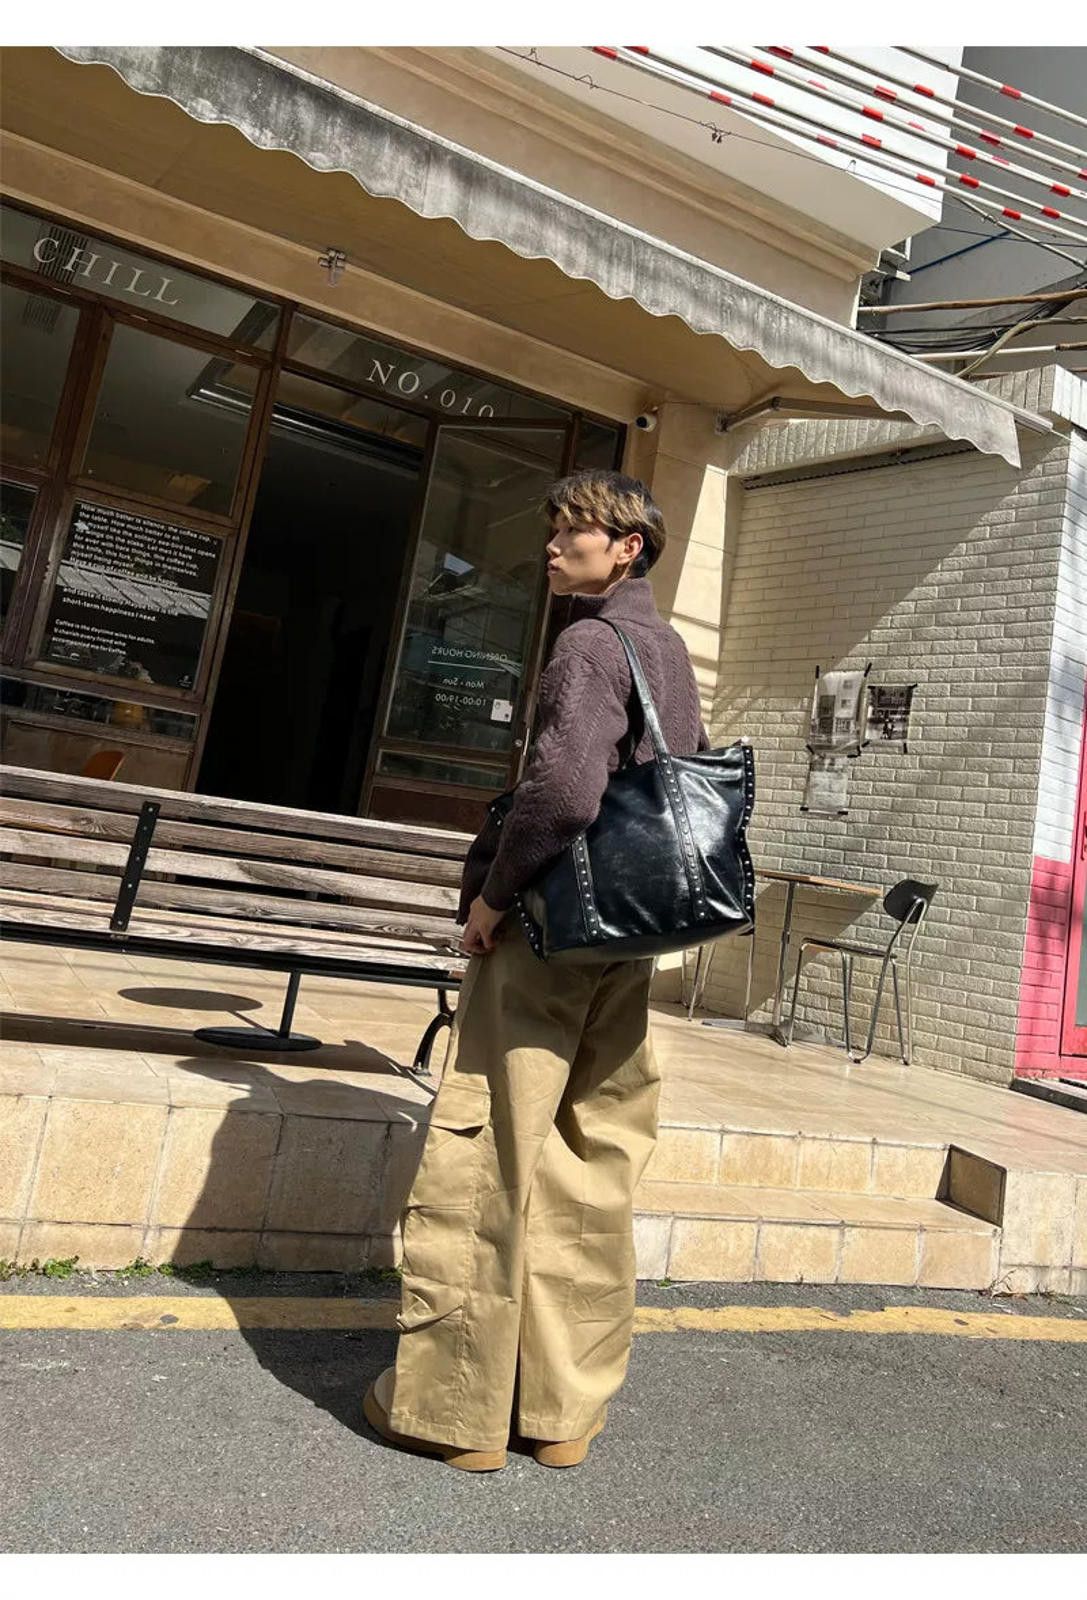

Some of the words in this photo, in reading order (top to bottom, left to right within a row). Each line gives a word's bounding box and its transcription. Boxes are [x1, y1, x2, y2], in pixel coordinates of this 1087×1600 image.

[33, 237, 180, 305] CHILL
[80, 511, 90, 519] the
[100, 604, 135, 618] happiness
[55, 618, 74, 628] Coffee
